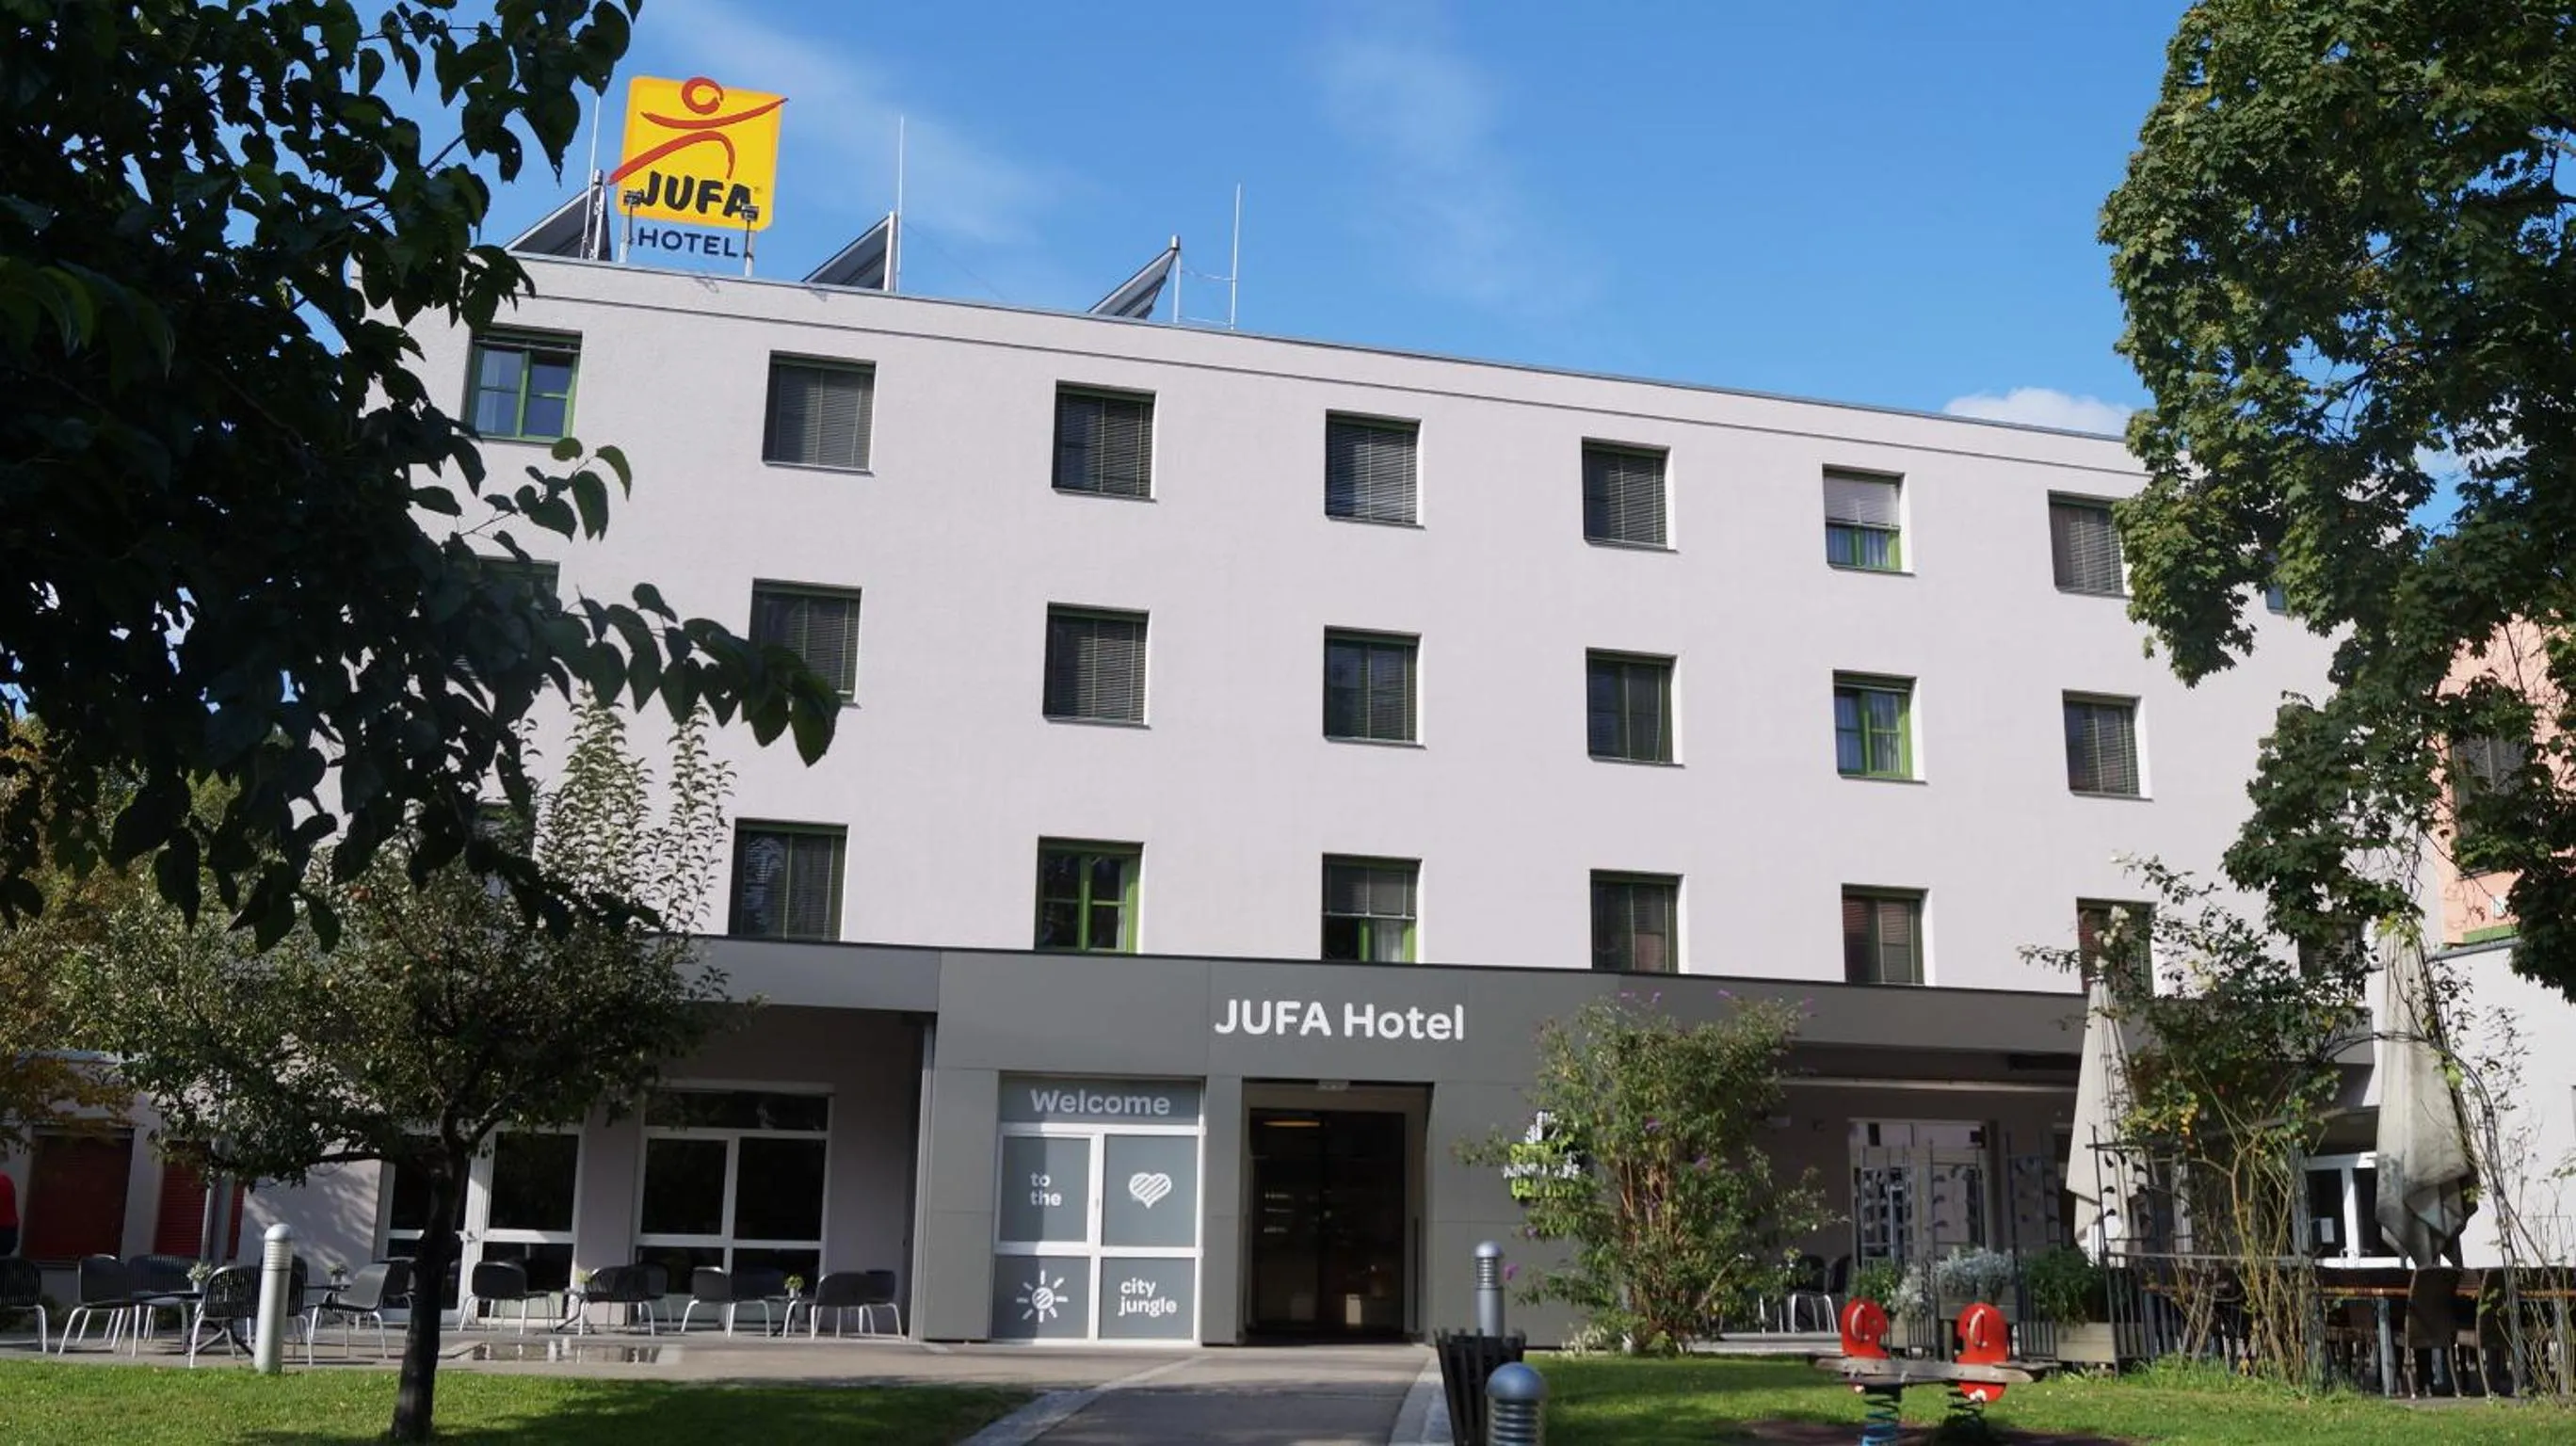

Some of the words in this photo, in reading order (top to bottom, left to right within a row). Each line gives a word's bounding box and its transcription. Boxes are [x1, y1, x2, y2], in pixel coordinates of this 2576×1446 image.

[641, 170, 751, 217] JUFA
[637, 227, 738, 257] HOTEL
[1215, 999, 1331, 1036] JUFA
[1344, 1004, 1464, 1040] Hotel
[1030, 1088, 1170, 1116] Welcome
[1031, 1171, 1051, 1188] to
[1031, 1189, 1062, 1207] the
[1120, 1277, 1156, 1297] city
[1118, 1296, 1177, 1317] jungle
